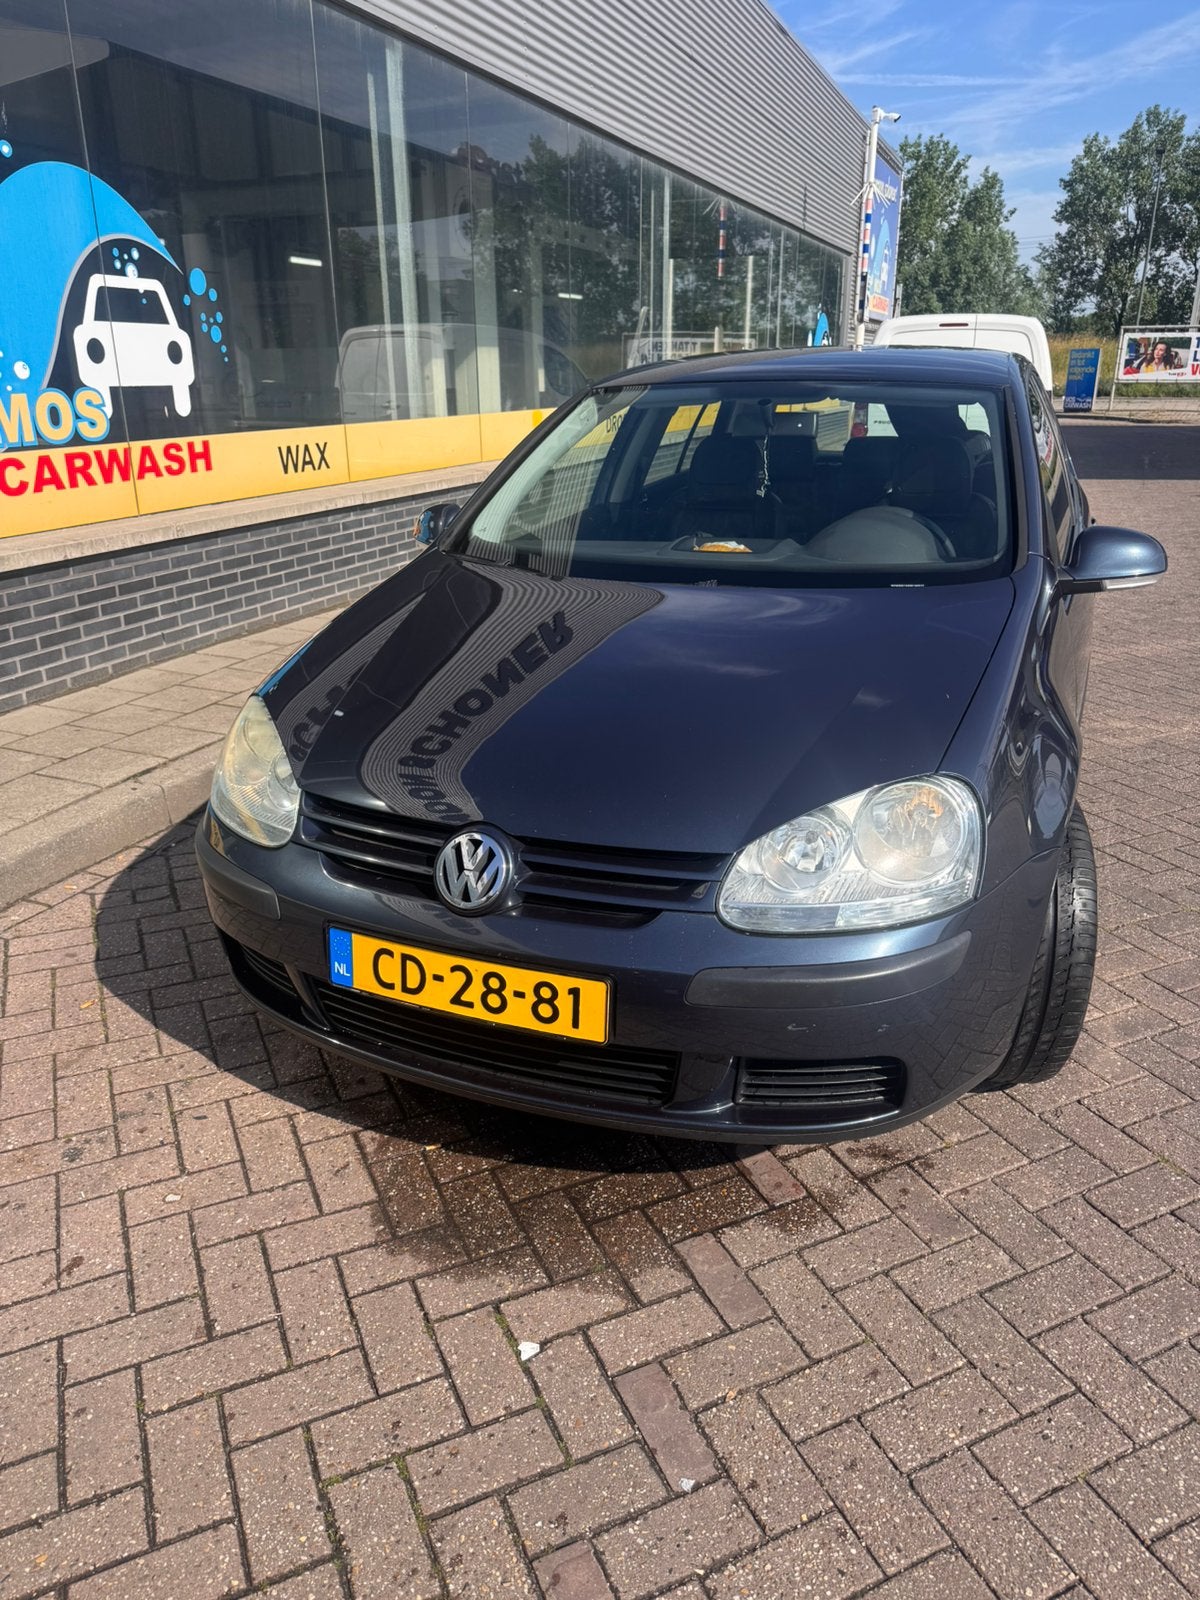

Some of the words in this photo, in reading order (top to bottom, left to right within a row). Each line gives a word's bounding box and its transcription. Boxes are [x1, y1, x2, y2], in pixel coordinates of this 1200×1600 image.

[0, 440, 213, 497] CARWASH
[278, 442, 331, 474] WAX
[334, 961, 351, 977] NL
[372, 947, 581, 1030] CD-28-81
